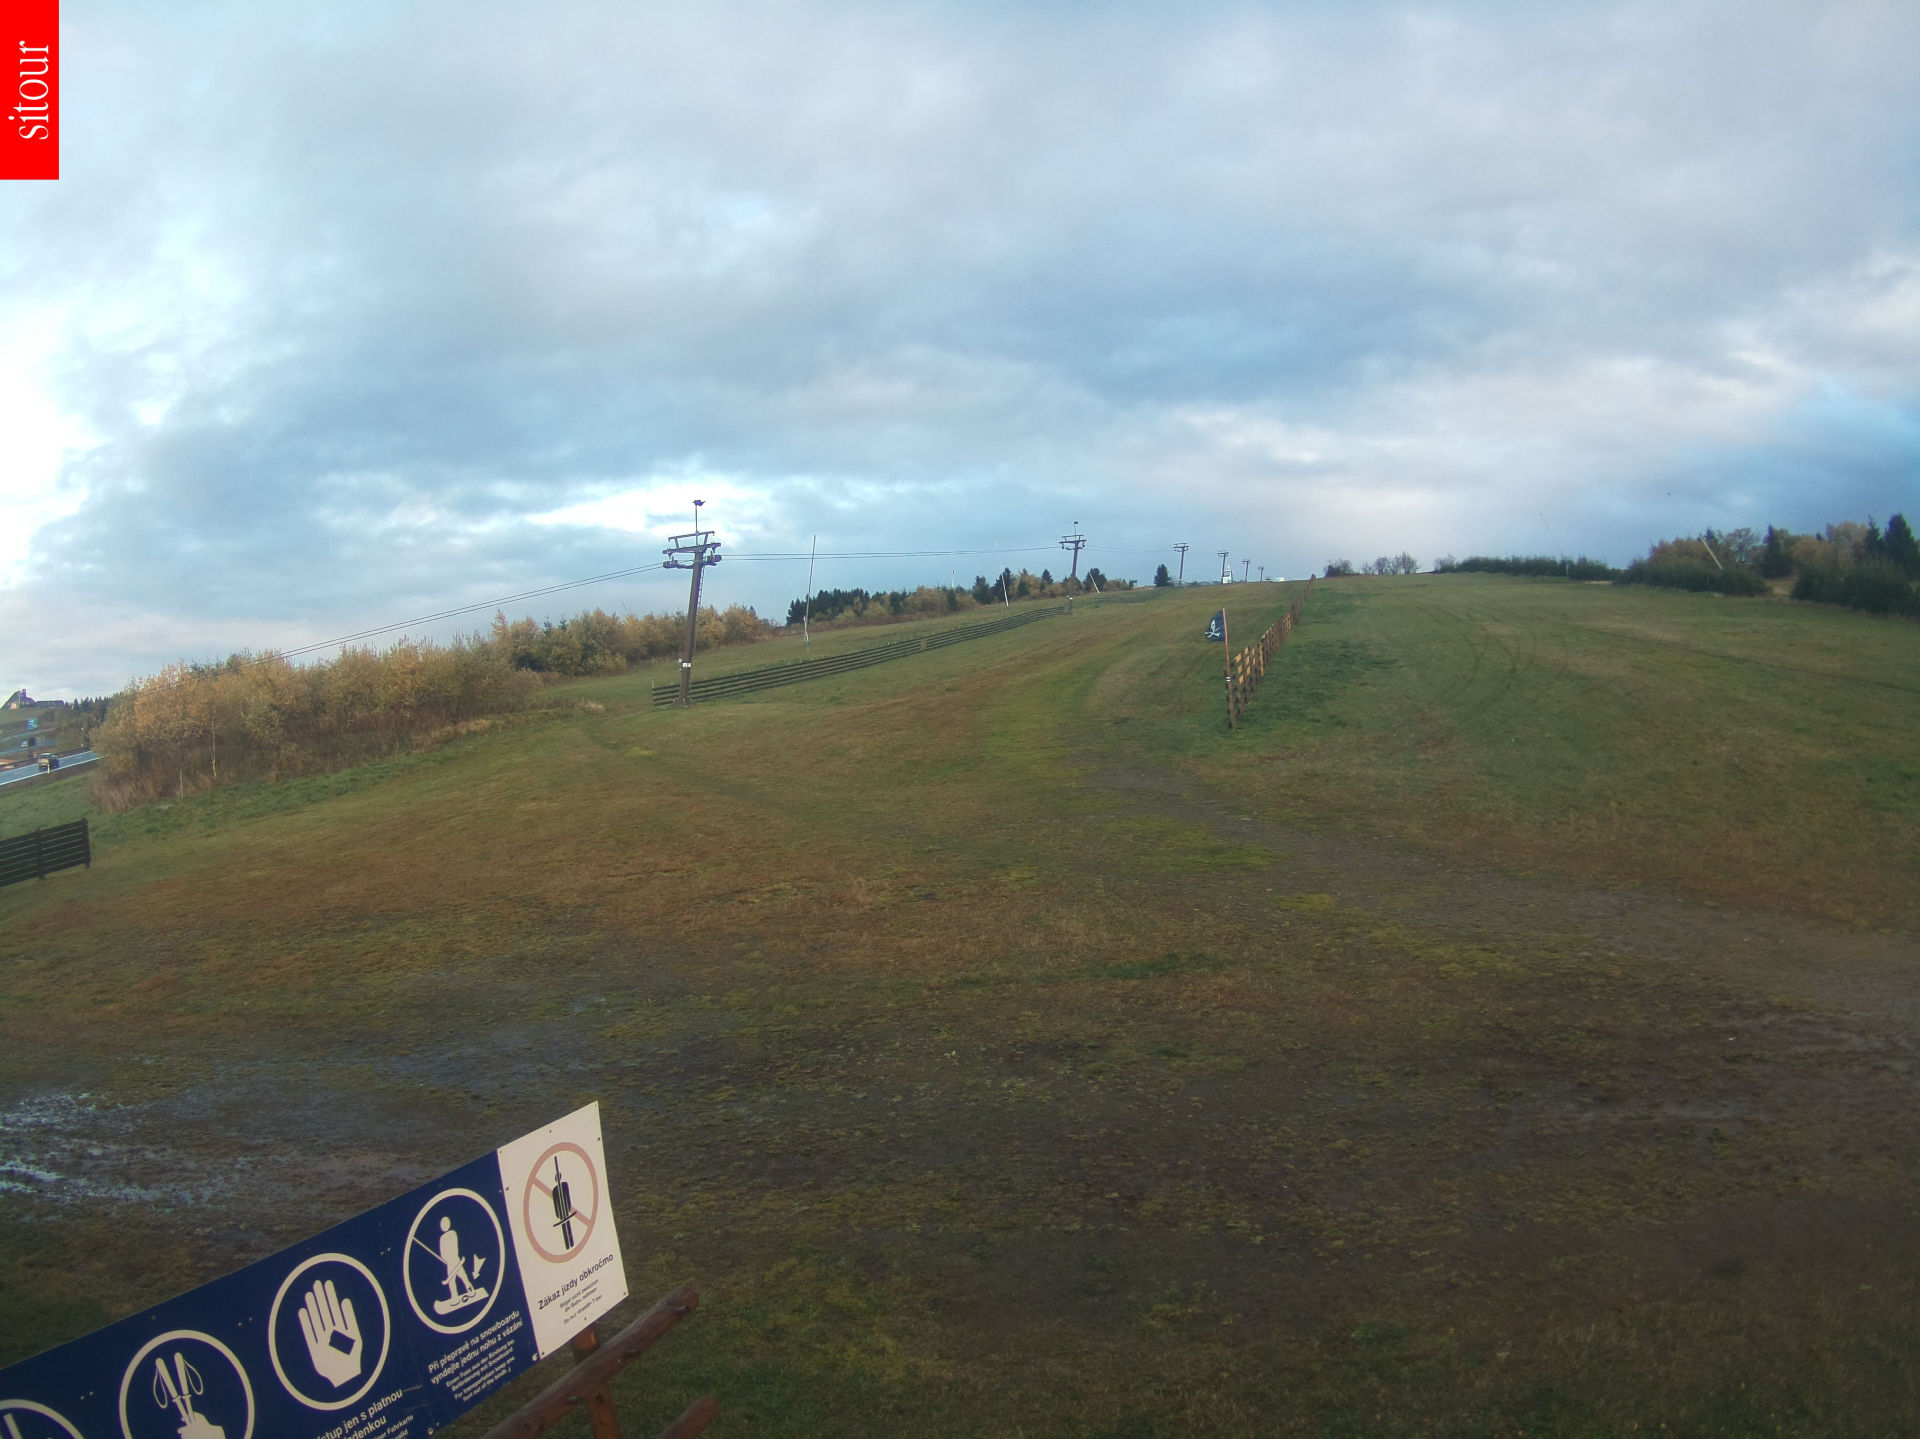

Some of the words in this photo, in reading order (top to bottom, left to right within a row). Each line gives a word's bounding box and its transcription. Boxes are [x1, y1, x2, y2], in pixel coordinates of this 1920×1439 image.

[538, 1290, 561, 1310] Zákaz
[579, 1254, 614, 1281] obkročmo
[480, 1310, 520, 1340] snowboardu
[460, 1348, 480, 1367] jednu
[480, 1337, 497, 1353] nohu
[317, 1427, 343, 1439] tup
[342, 1416, 359, 1434] jen
[360, 1411, 367, 1421] s
[367, 1389, 404, 1419] platnou
